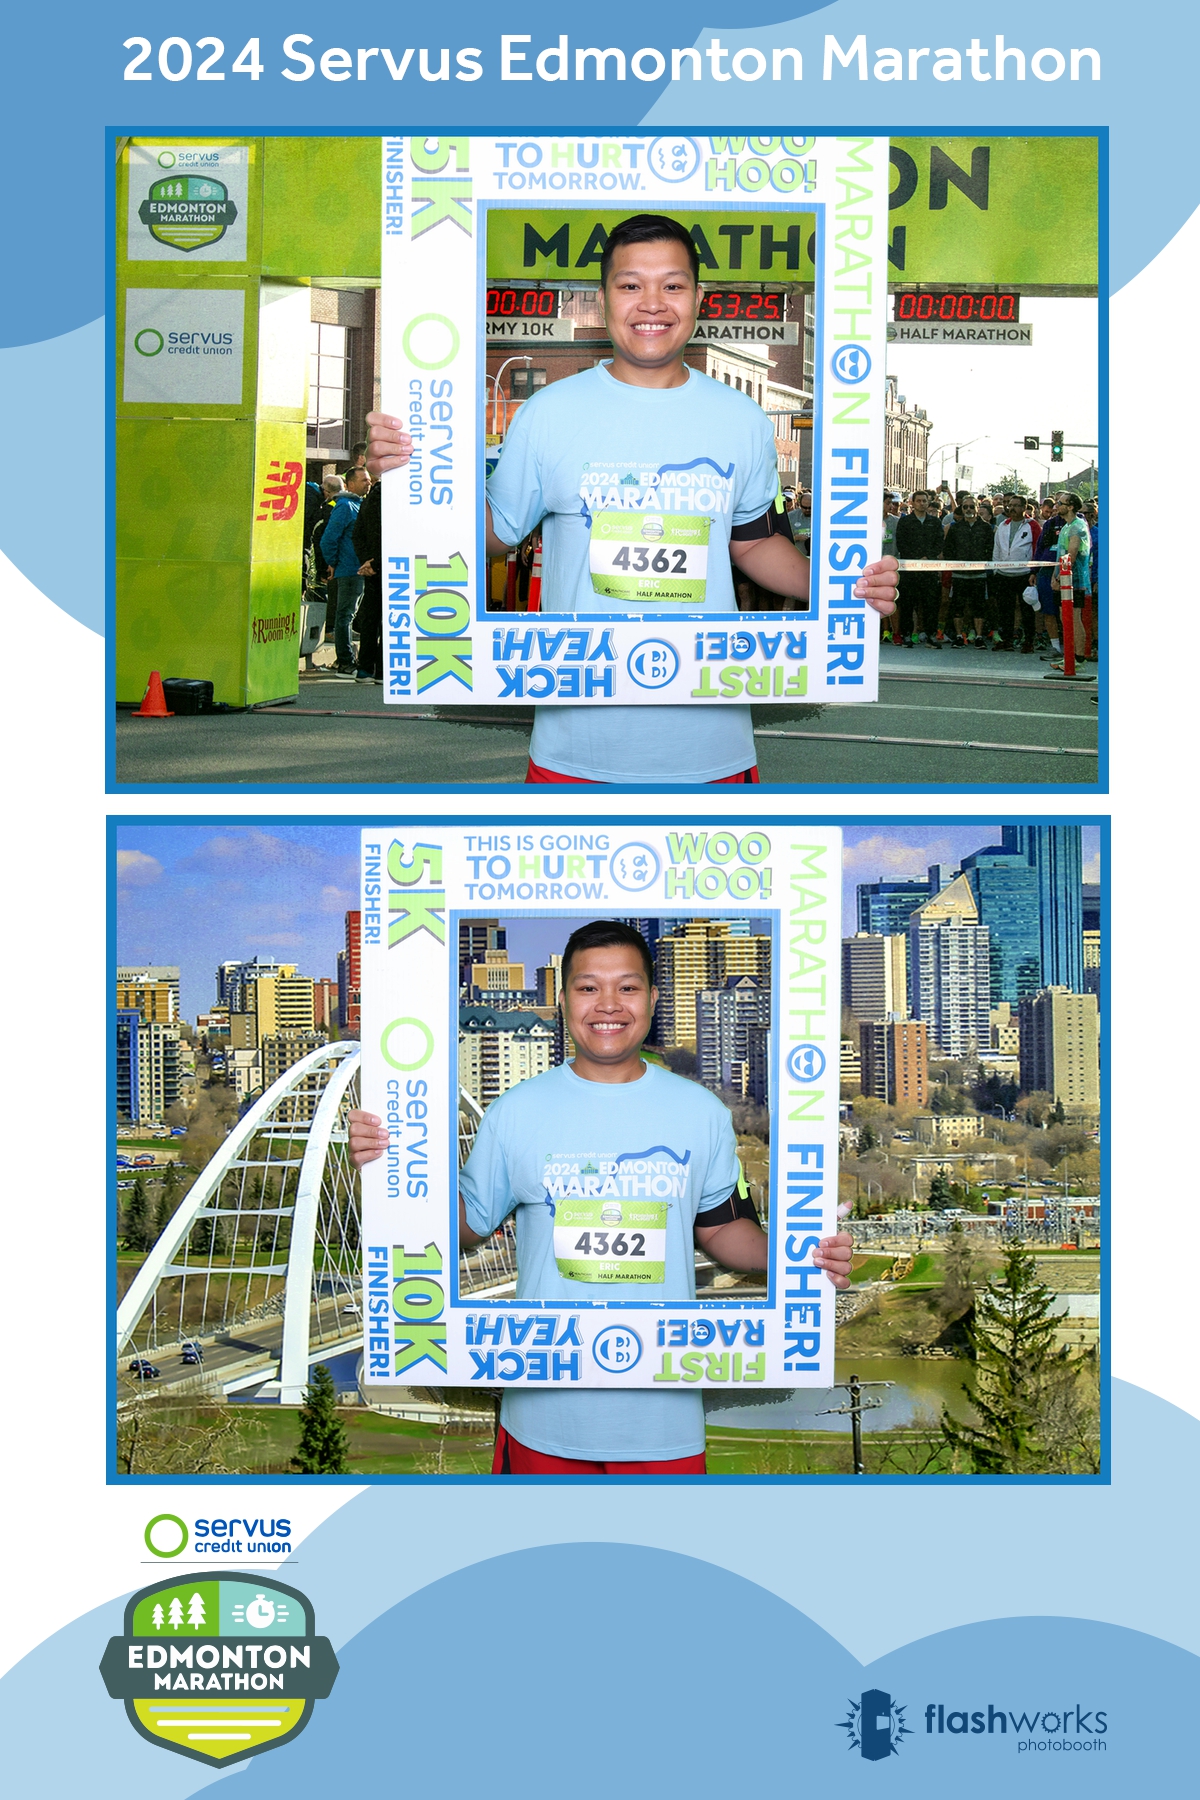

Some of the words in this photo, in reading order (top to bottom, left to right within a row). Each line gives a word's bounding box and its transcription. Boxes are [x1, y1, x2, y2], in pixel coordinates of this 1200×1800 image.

[178, 152, 219, 162] servus
[495, 142, 543, 168] TO
[552, 142, 645, 169] HURT
[386, 137, 404, 235] INISHER!
[410, 137, 472, 241] 5K
[493, 172, 646, 190] TOMORROW.
[705, 158, 817, 193] HOO!
[150, 202, 226, 214] EDMONTON
[160, 214, 215, 222] MARATHON
[168, 331, 233, 345] servus
[522, 323, 554, 336] 10K
[694, 326, 784, 340] ARATHON
[900, 328, 939, 340] HALF
[943, 328, 1031, 341] MARATHON
[168, 345, 200, 354] credit
[203, 346, 233, 355] union
[410, 379, 426, 441] credit
[430, 379, 453, 505] servus
[410, 447, 422, 505] union
[580, 472, 619, 486] 2024
[640, 472, 733, 492] EDMONTON
[579, 487, 731, 514] MARATHON
[612, 546, 687, 574] 4362
[826, 448, 869, 685] FINISHER!
[638, 580, 660, 588] ERIC
[258, 613, 290, 636] Running
[388, 556, 411, 696] FINISHER!
[414, 551, 473, 695] 10K
[492, 628, 618, 662] YEAH!
[497, 664, 617, 699] HECK
[692, 665, 808, 698] FIRST
[464, 836, 511, 851] THIS
[517, 835, 534, 851] IS
[540, 834, 610, 851] GOING
[666, 832, 771, 865] WOO
[466, 856, 512, 880] TO
[519, 855, 608, 880] HURT
[664, 866, 772, 900] HOO!
[365, 844, 382, 944] FINISHER!
[387, 838, 446, 950] 5K
[464, 882, 608, 900] TOMORROW.
[387, 1079, 404, 1138] credit
[406, 1079, 428, 1198] servus
[388, 1142, 400, 1198] union
[544, 1163, 580, 1176] 2024
[600, 1161, 690, 1178] EDMONTON
[552, 1152, 576, 1160] servus
[543, 1176, 688, 1198] MARATHON
[574, 1232, 646, 1256] 4362
[784, 1144, 824, 1372] FINISHER!
[600, 1262, 620, 1271] ERIC
[368, 1246, 390, 1378] FINISHER!
[392, 1241, 448, 1377] 10K
[466, 1314, 584, 1346] YEAH!
[469, 1348, 582, 1381] HECK
[654, 1352, 766, 1382] FIRST
